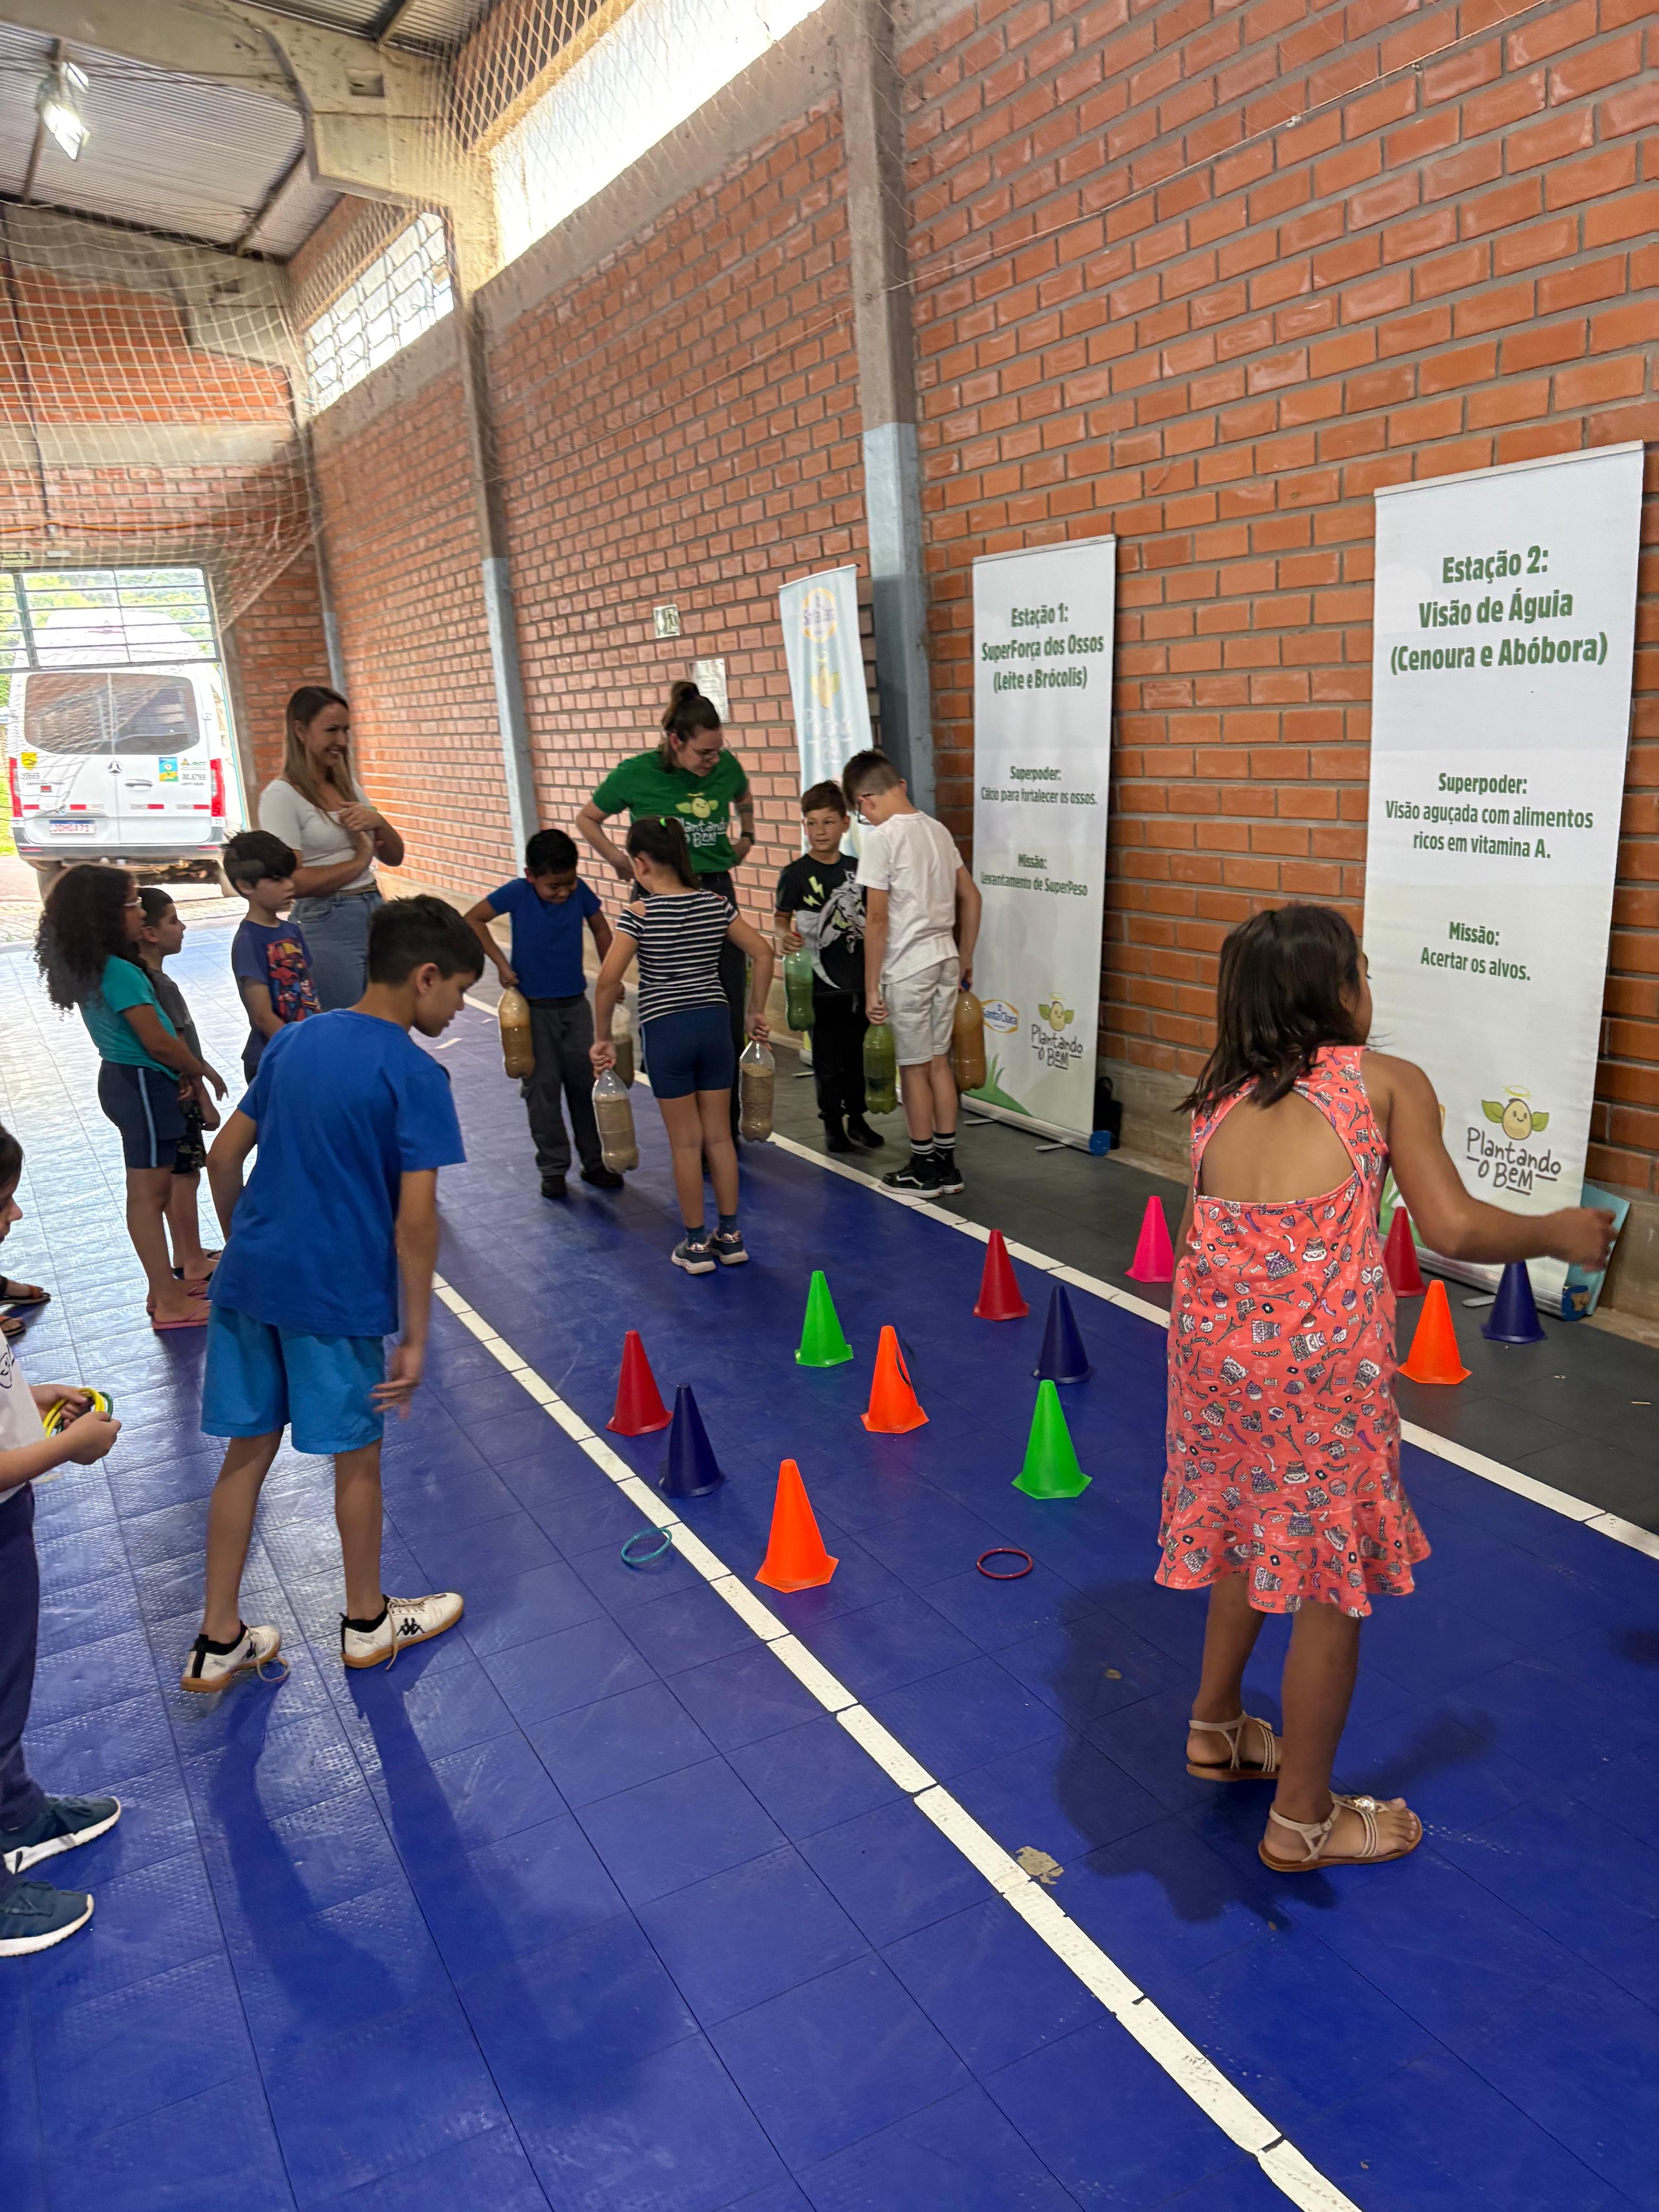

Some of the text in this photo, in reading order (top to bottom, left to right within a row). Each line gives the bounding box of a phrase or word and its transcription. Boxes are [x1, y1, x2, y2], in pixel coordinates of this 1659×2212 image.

[1443, 545, 1548, 584] Estação 2:
[1011, 602, 1069, 629] Estação 1:
[1419, 588, 1573, 628] Visão de Águia
[1044, 636, 1065, 656] dos
[1068, 634, 1104, 655] Ossos
[1391, 631, 1608, 675] (Cenoura e Abóbora)
[993, 666, 1087, 693] (Leite e Brócolis)
[1001, 791, 1019, 802] para
[1021, 788, 1059, 803] fortalecer
[1059, 794, 1069, 804] os
[1438, 773, 1528, 795] Superpoder:
[1385, 800, 1593, 829] Visão aguçada com alimentos
[1413, 832, 1551, 859] ricos em vitamina A.
[1033, 877, 1043, 891] de
[1449, 921, 1499, 946] Missão:
[1420, 948, 1531, 981] Acertar os alvos.
[1031, 1024, 1083, 1053] Plantando
[1467, 1127, 1562, 1175] Plantando
